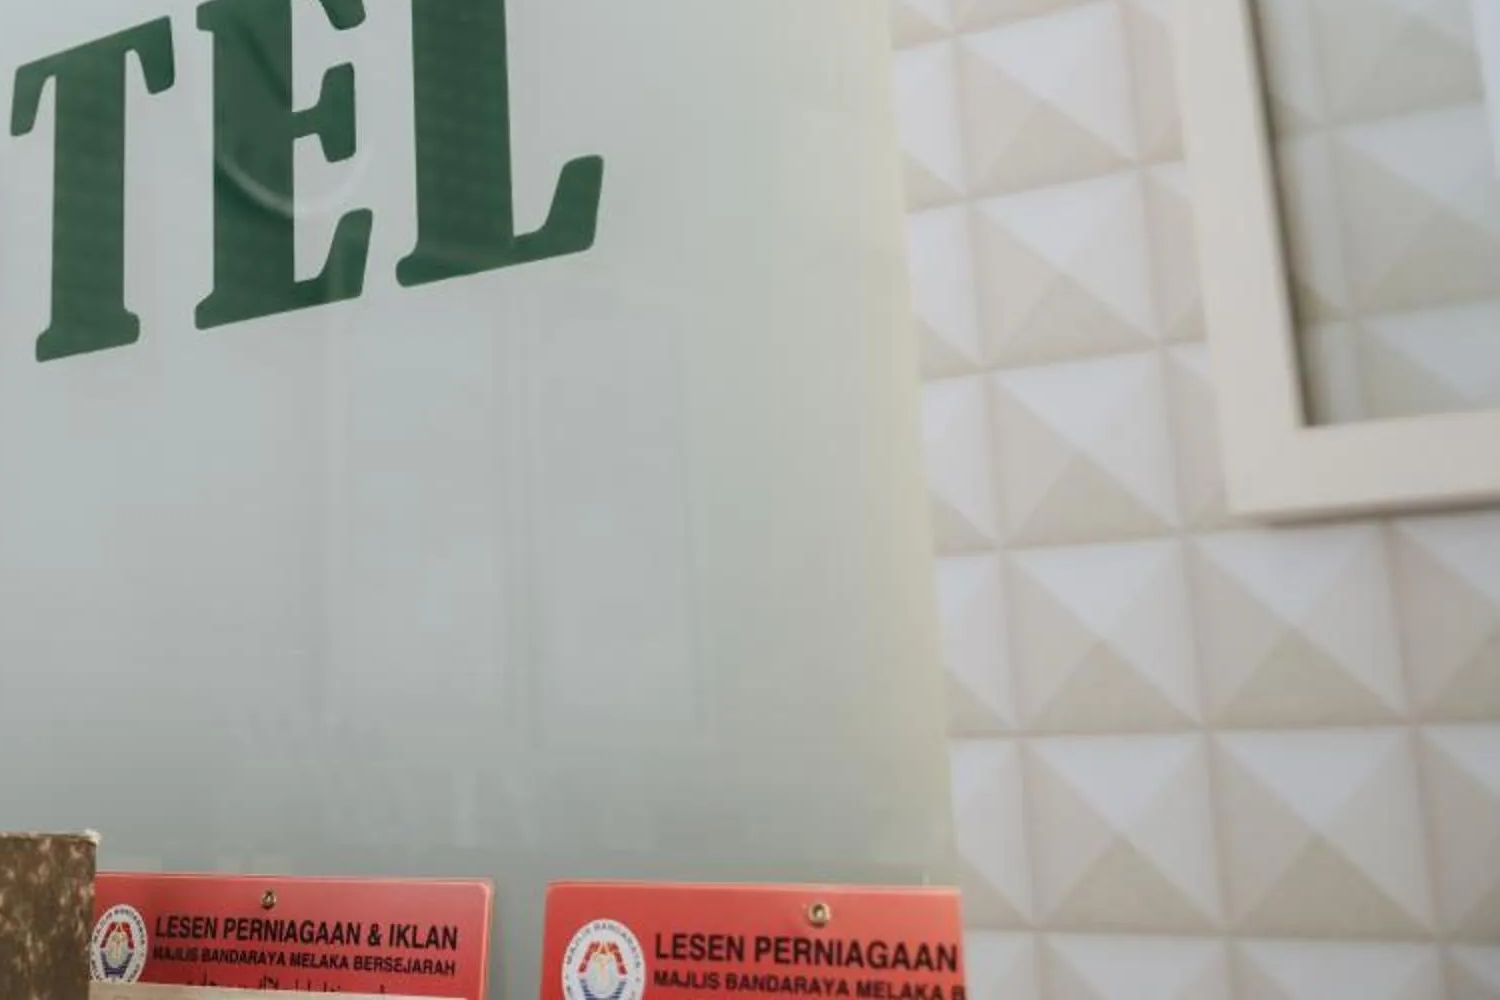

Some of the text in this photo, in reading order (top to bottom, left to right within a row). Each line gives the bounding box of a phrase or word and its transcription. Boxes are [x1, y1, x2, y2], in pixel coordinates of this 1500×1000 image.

[155, 915, 458, 951] LESEN PERNIAGAAN & IKLAN
[152, 945, 456, 977] MAJLIS BANDARAYA MELAKA BERSEJARAH
[654, 931, 745, 963] LESEN
[754, 935, 958, 973] PERNIAGAAN
[653, 968, 720, 990] MAJLIS
[725, 971, 850, 996] BANDARAYA
[855, 979, 948, 1000] MELAKA
